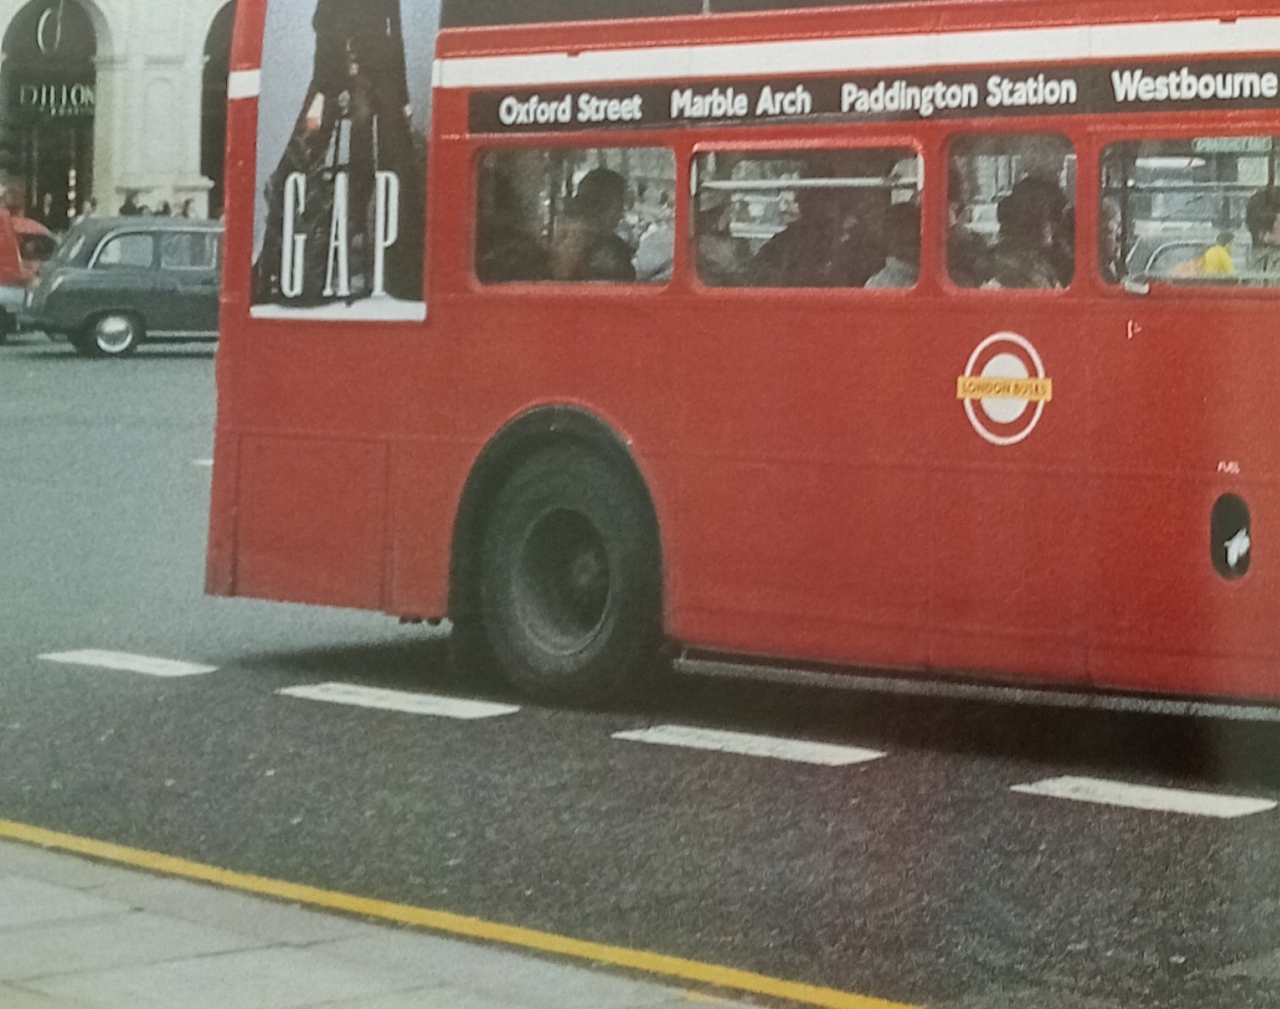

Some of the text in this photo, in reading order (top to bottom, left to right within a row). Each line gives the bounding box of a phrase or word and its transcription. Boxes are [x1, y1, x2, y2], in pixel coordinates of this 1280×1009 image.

[499, 94, 572, 126] Oxford
[576, 92, 643, 123] Street
[670, 85, 748, 119] Marble
[755, 84, 812, 117] Arch
[840, 79, 979, 117] Paddington
[985, 73, 1078, 108] Station
[1111, 66, 1279, 103] Westbourne
[280, 170, 400, 299] GAP
[962, 380, 1011, 396] LONDON
